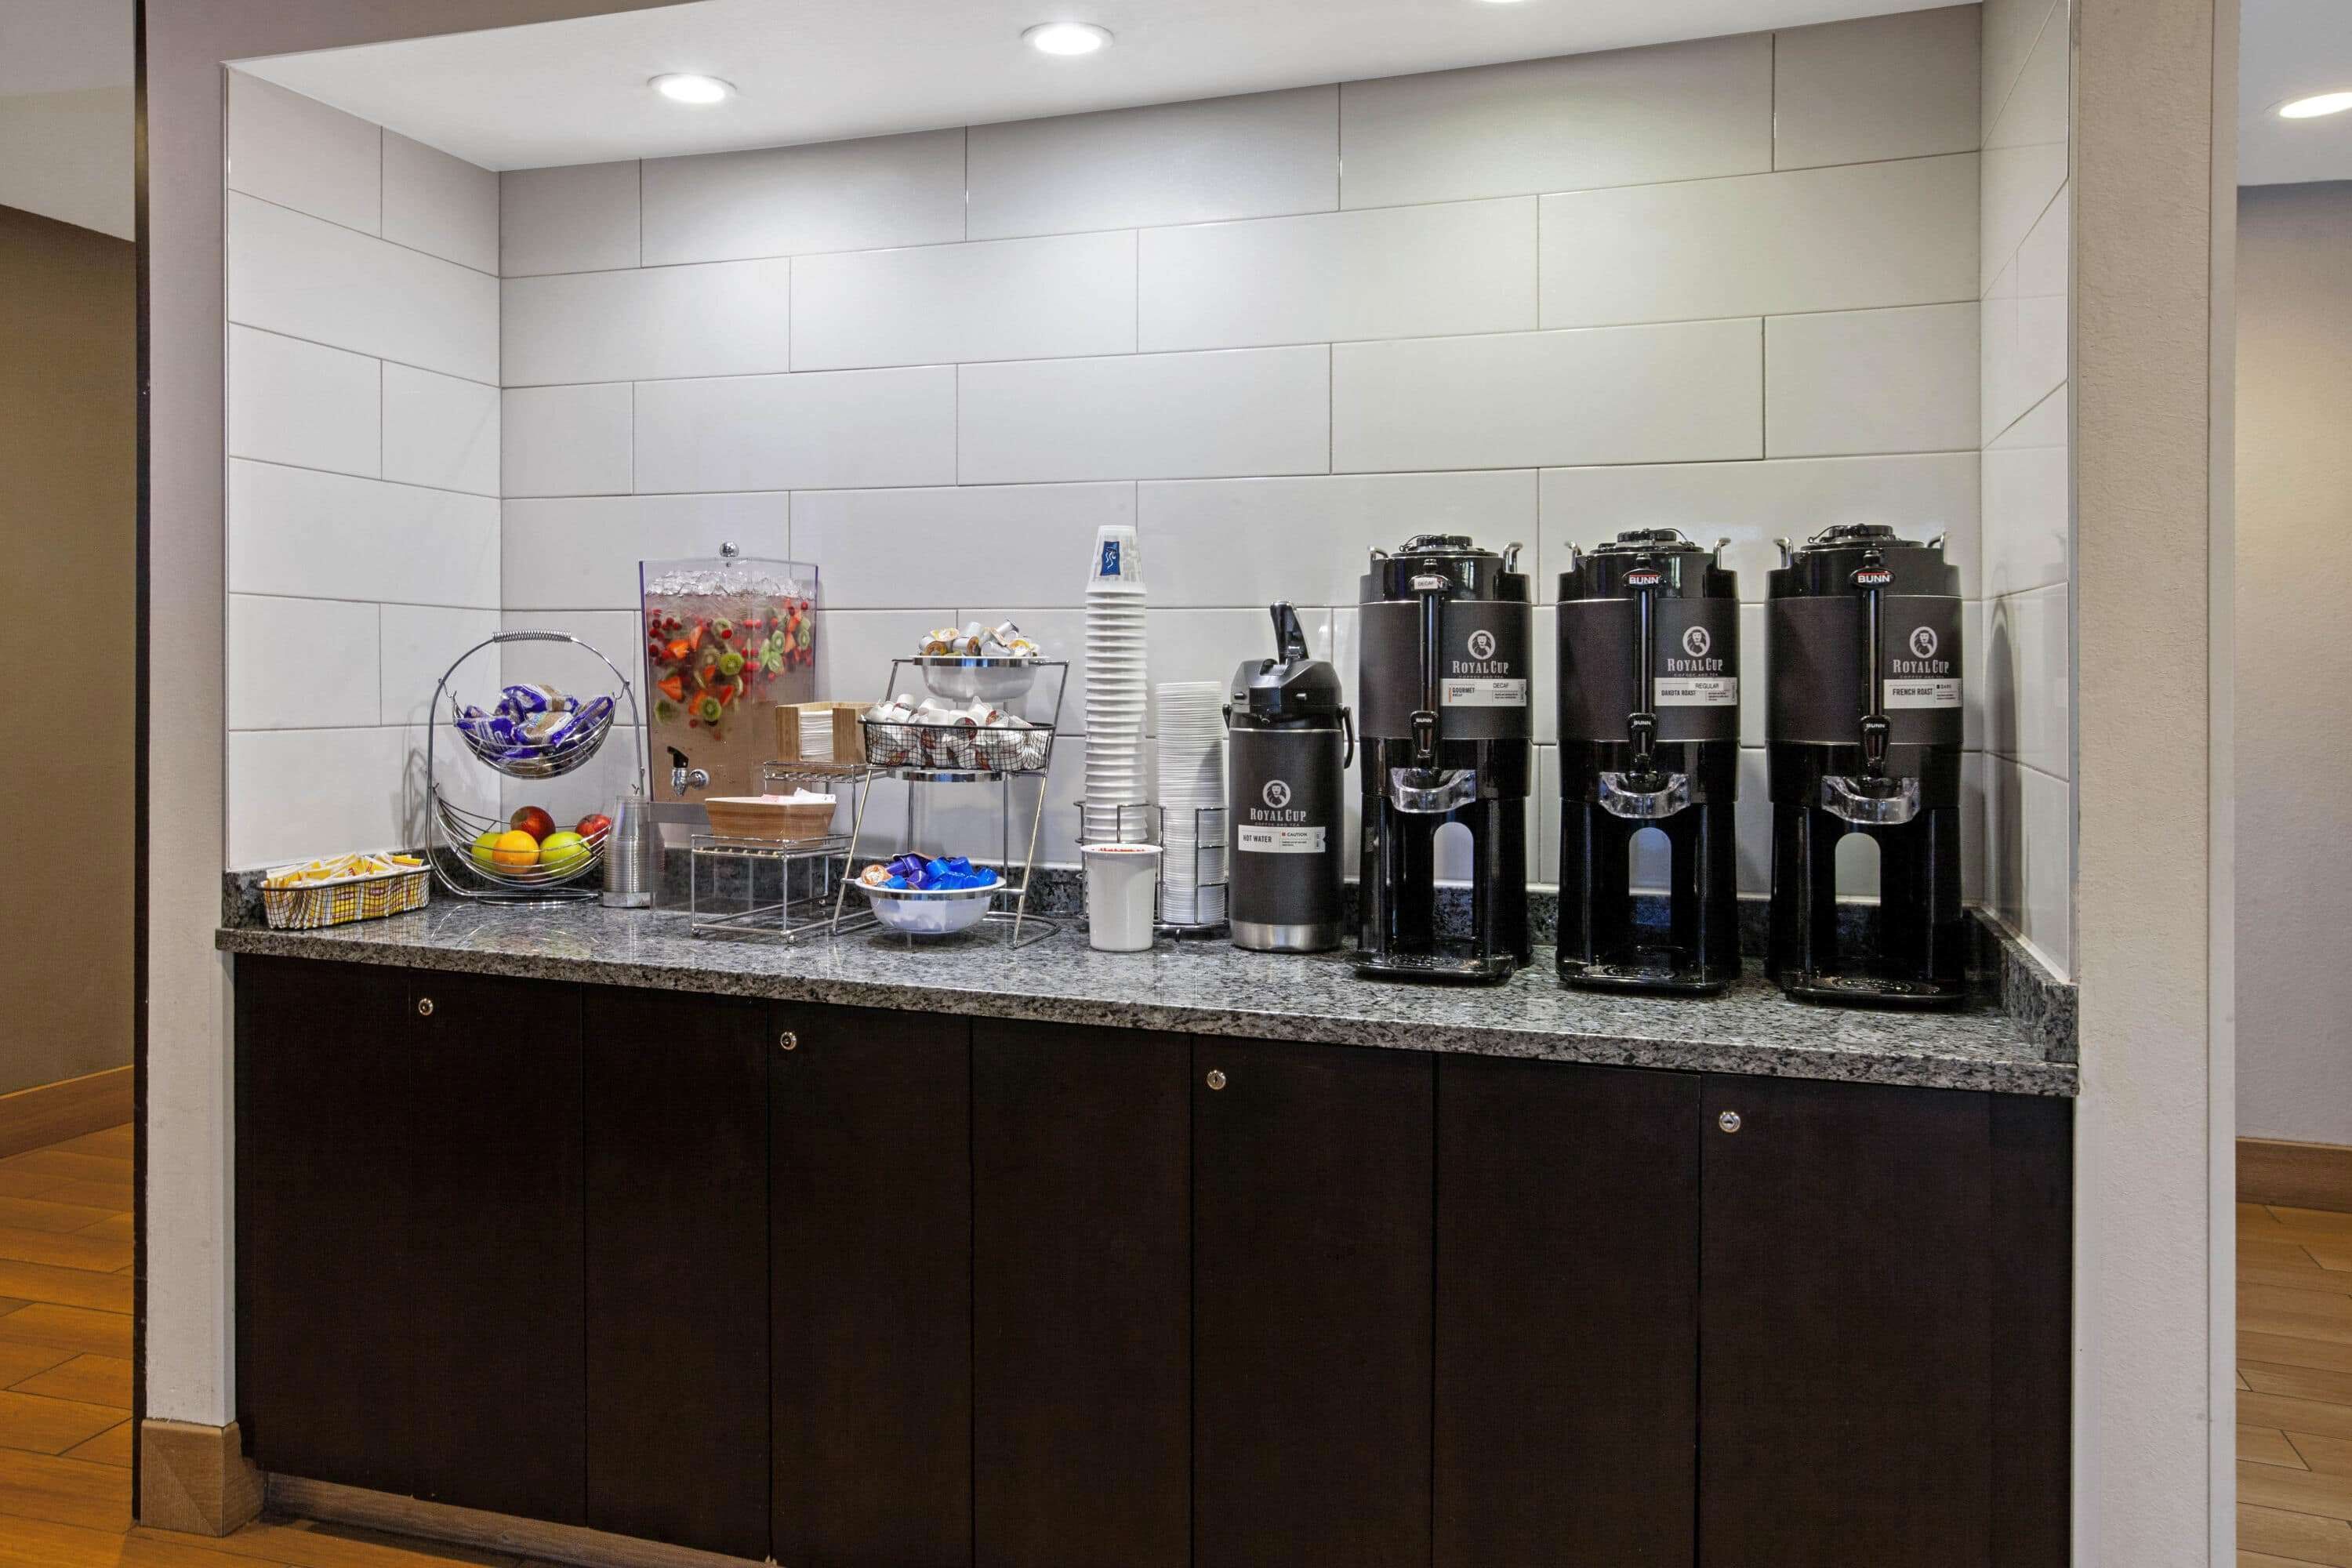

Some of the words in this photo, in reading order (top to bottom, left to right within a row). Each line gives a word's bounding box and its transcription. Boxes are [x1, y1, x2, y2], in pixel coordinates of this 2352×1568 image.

[1857, 575, 1890, 583] BUNN
[1452, 660, 1490, 673] ROYAL
[1490, 660, 1509, 674] CUP
[1668, 659, 1704, 672] ROYAL
[1705, 658, 1723, 672] CUP
[1893, 659, 1931, 673] ROYAL
[1932, 659, 1950, 673] CUP
[1250, 808, 1283, 822] ROYAL
[1285, 808, 1307, 822] CUP
[1253, 834, 1272, 843] WATER
